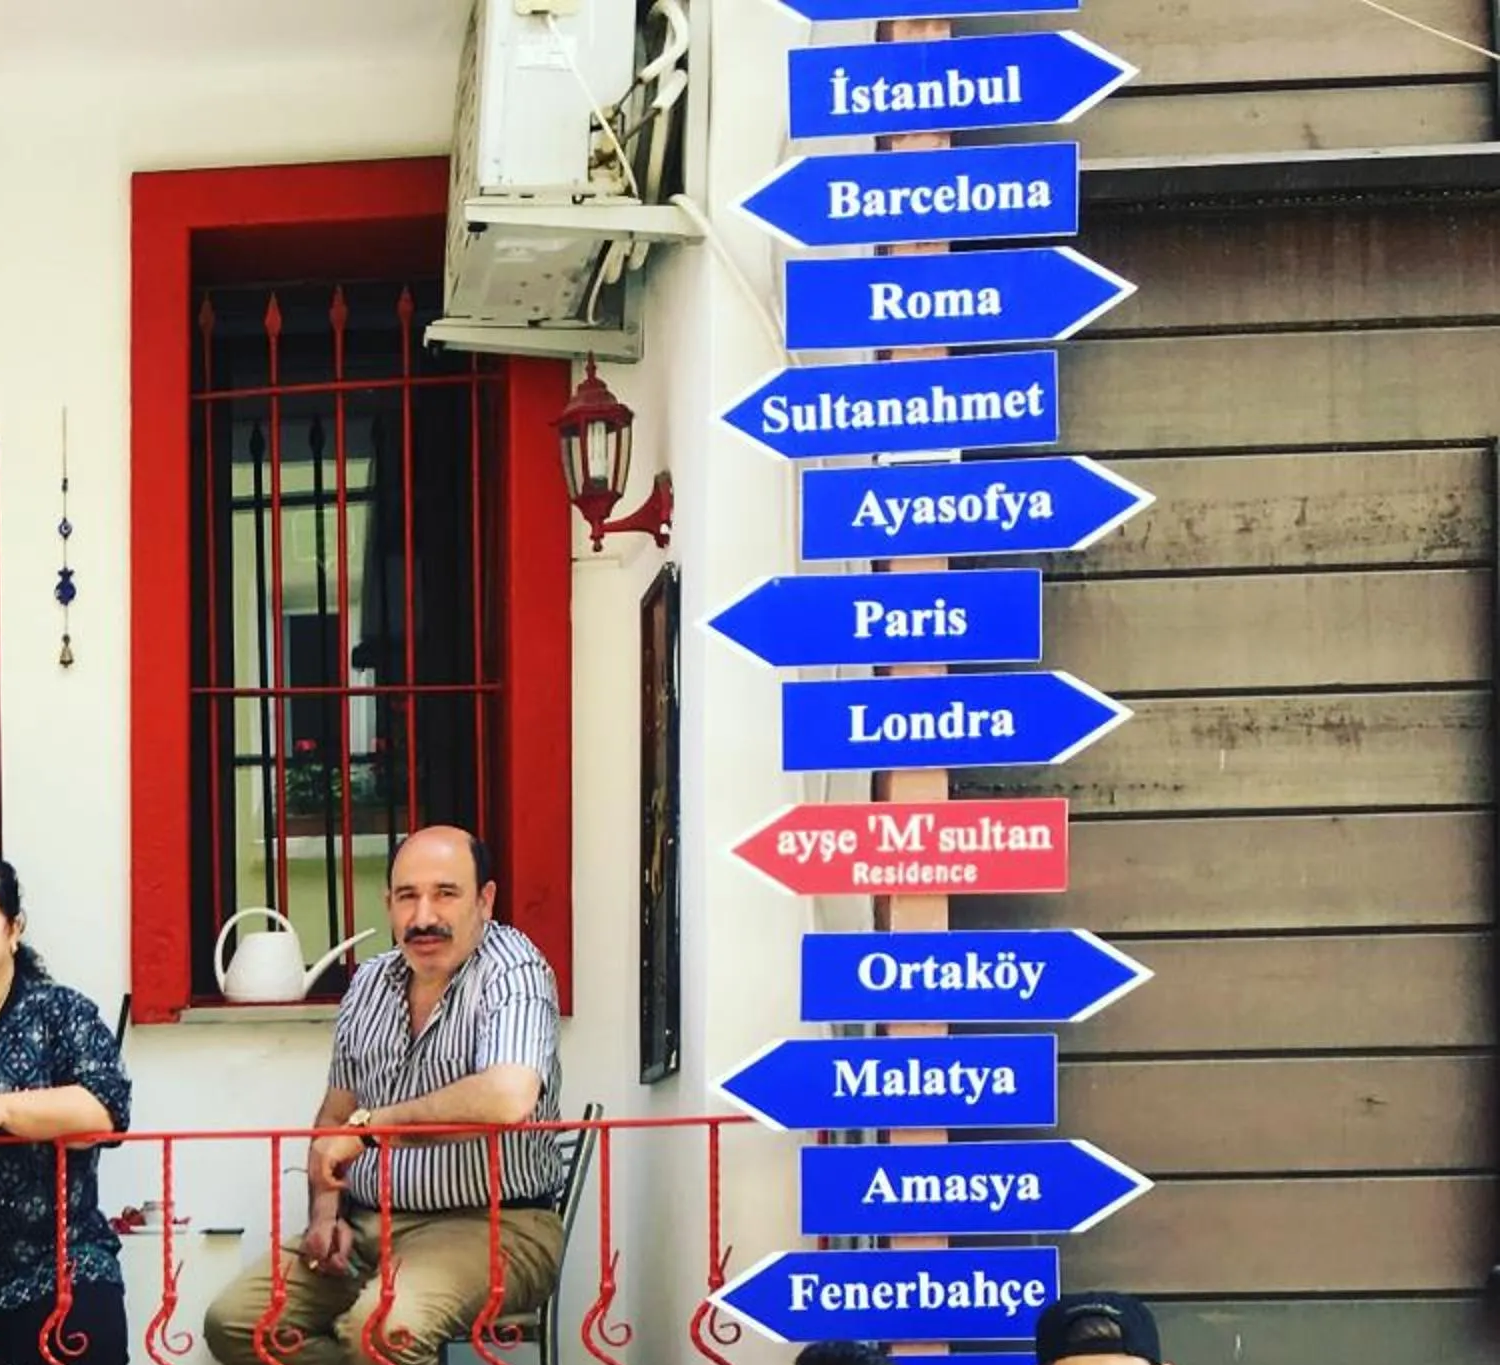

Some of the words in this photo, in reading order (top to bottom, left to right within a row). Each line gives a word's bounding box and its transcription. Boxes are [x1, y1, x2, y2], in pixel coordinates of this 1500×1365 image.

[831, 66, 1021, 115] İstanbul
[828, 176, 1051, 219] Barcelona
[869, 283, 1002, 321] Roma
[761, 382, 1044, 434] Sultanahmet
[851, 483, 1053, 536] Ayasofya
[853, 599, 967, 638] Paris
[848, 702, 1015, 743] Londra
[777, 826, 857, 862] ayşe
[938, 817, 1053, 852] sultan
[852, 862, 977, 885] Residence
[857, 952, 1046, 999] Ortaköy
[833, 1060, 1016, 1105] Malatya
[861, 1167, 1042, 1211] Amasya
[788, 1271, 1046, 1316] Fenerbahçe
